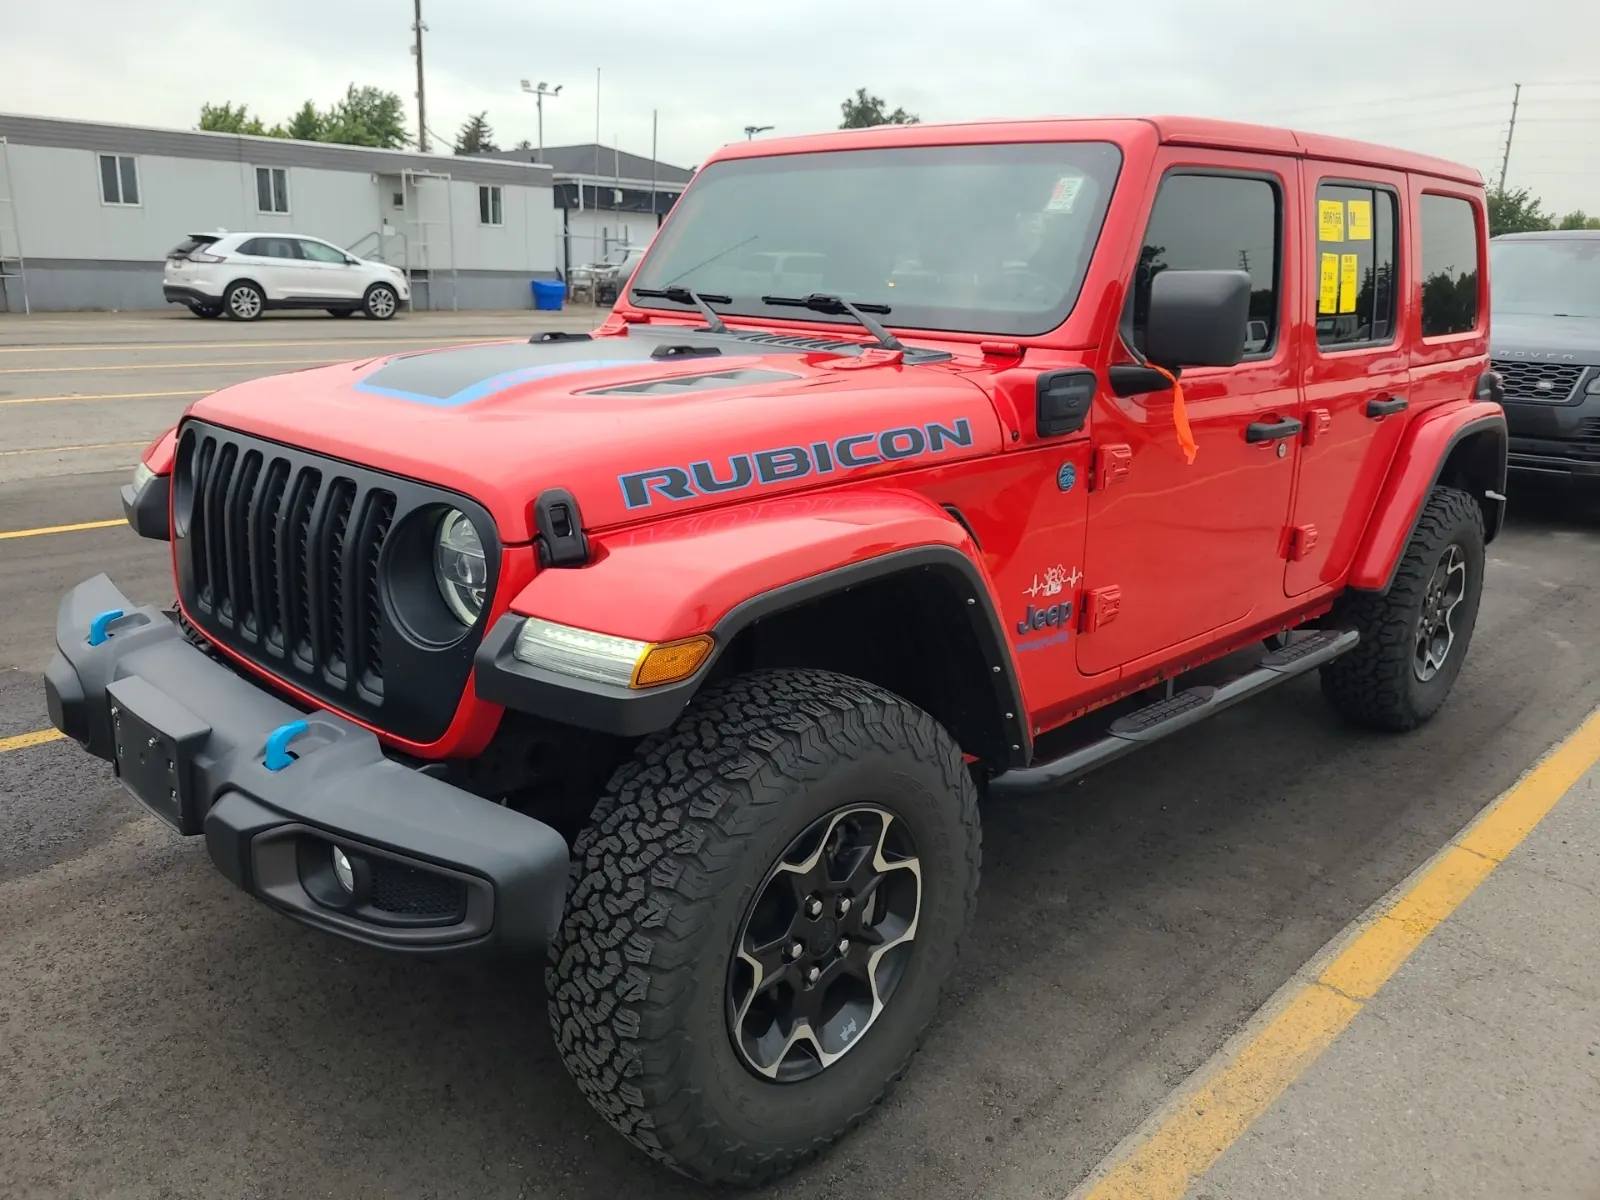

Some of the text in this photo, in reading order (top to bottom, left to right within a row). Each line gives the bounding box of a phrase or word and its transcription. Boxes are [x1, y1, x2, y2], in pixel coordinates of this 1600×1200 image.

[1499, 350, 1574, 360] ROVER
[617, 417, 973, 510] RUBICON
[1017, 600, 1072, 635] Jeep
